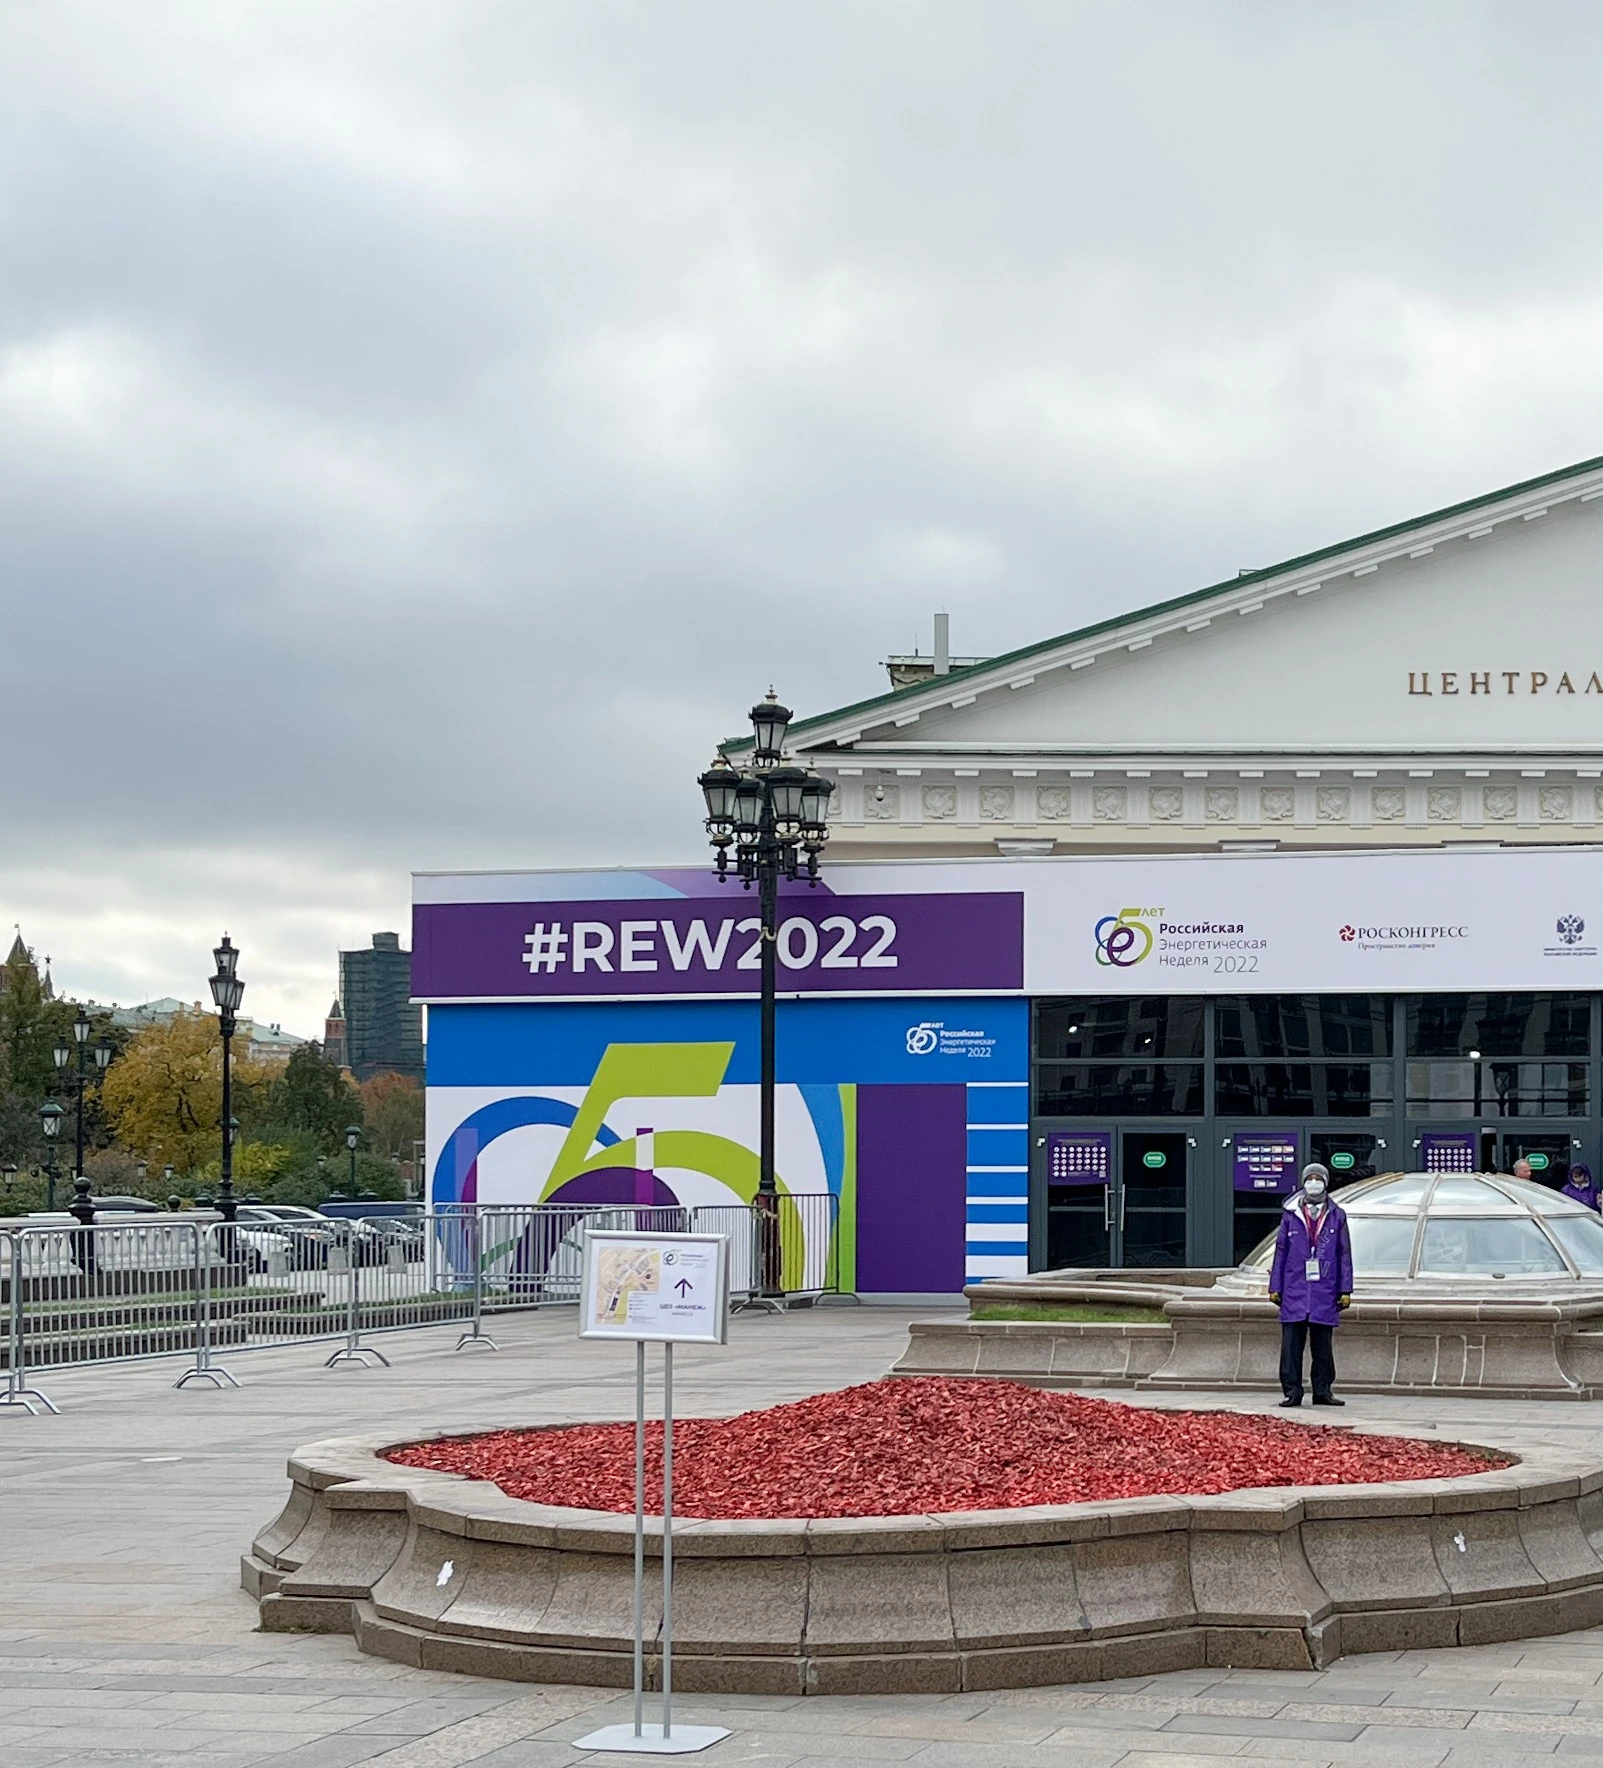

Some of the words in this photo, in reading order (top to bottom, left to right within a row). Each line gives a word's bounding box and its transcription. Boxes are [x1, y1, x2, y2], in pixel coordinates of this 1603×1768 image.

[1158, 922, 1244, 935] Российская
[1357, 926, 1470, 939] РОСКОНГРЕСС
[521, 915, 899, 974] #REW2022
[1158, 938, 1268, 952] Энергетическая
[1158, 954, 1209, 967] Неделя
[1212, 955, 1260, 974] 2022
[967, 1047, 992, 1058] 2022
